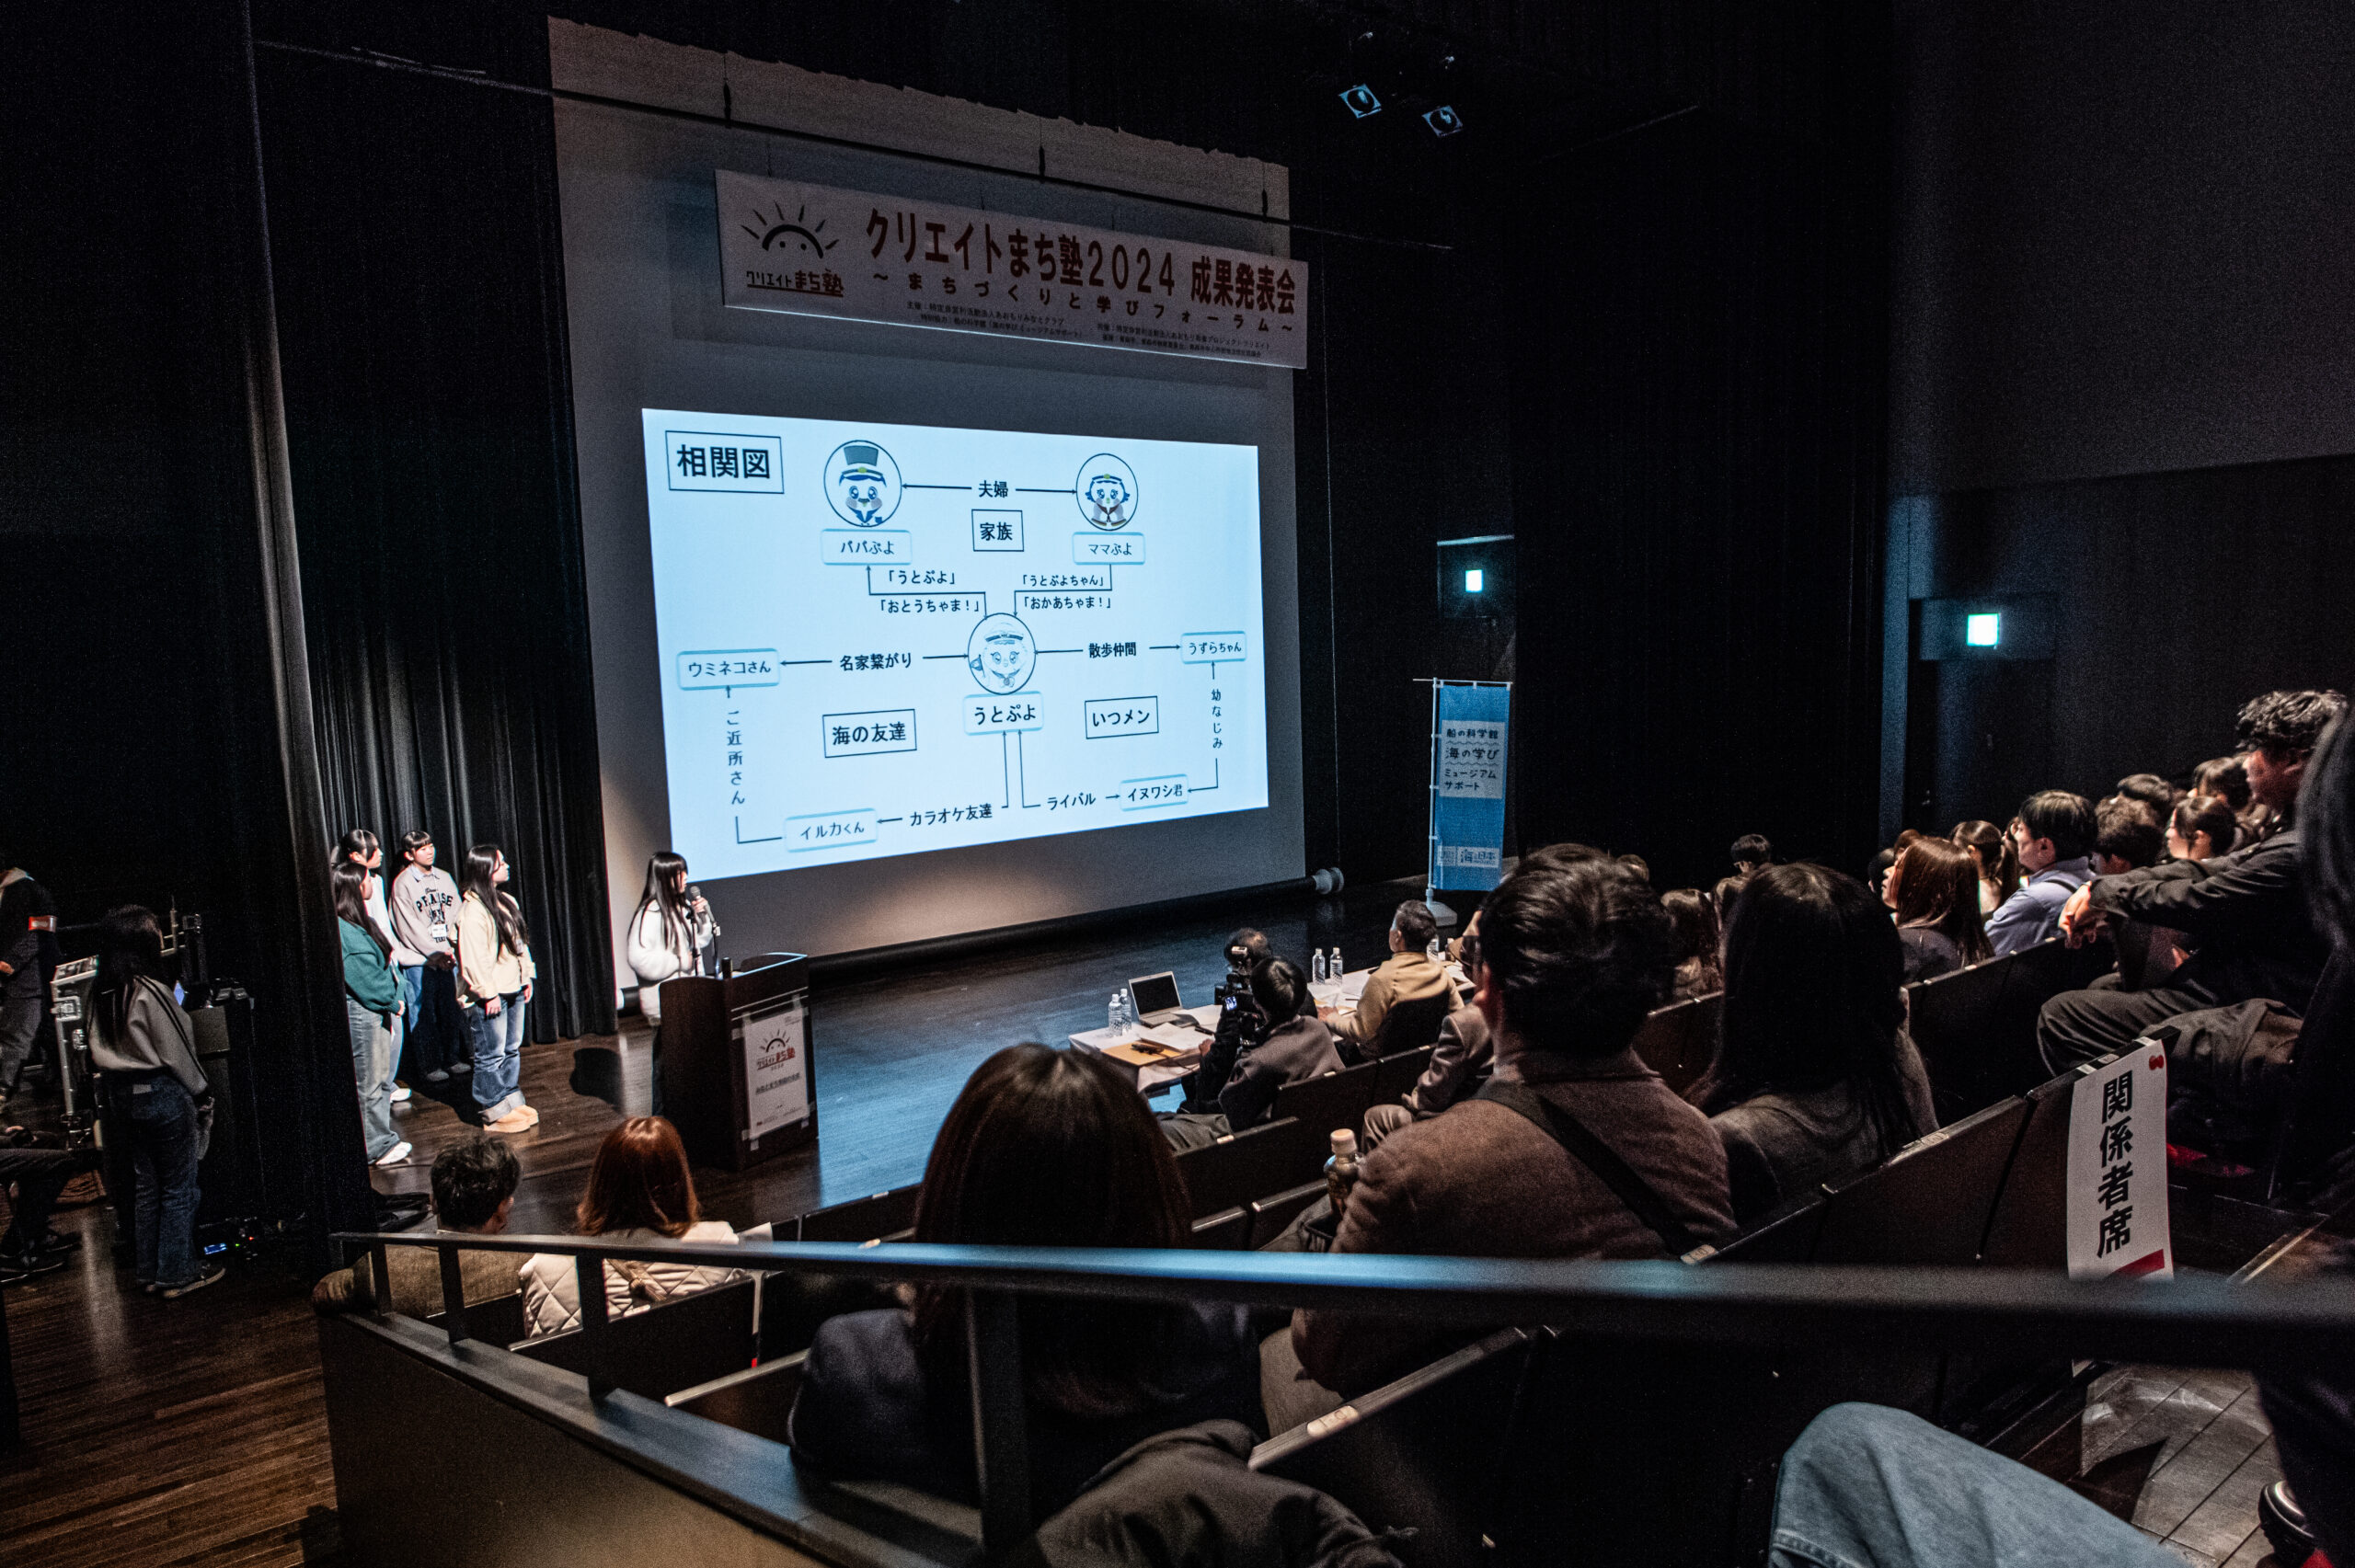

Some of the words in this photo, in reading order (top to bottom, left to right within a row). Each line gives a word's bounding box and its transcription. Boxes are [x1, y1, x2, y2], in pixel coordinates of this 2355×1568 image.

[867, 208, 1175, 296] クリエイトまち塾2024
[1190, 256, 1295, 315] 成果発表会
[746, 269, 844, 293] クリエイトまち塾
[676, 443, 771, 480] 相関図
[978, 479, 1009, 498] 夫婦
[979, 521, 1013, 542] 家族
[840, 540, 894, 555] パパぷよ
[1088, 542, 1132, 556] ママぷよ
[889, 569, 956, 585] 「うとぷよ」
[1088, 641, 1137, 659] 散歩仲間
[1189, 641, 1242, 656] うずらちゃん
[688, 660, 772, 678] ウミネコさん
[839, 652, 912, 671] 名家繋がり
[974, 704, 1037, 726] うとぷよ
[1092, 709, 1150, 727] いつメン
[1211, 688, 1223, 749] 幼なじみ
[832, 721, 906, 746] 海の友達
[1446, 728, 1499, 739] 船の科学館
[1445, 747, 1499, 761] 海の学び
[1444, 769, 1497, 780] ミュージアム
[1127, 784, 1183, 802] イヌワシ君
[1444, 781, 1480, 791] サポート
[1047, 792, 1097, 811] ライバル
[910, 803, 993, 827] カラオケ友達
[800, 821, 865, 841] イルカくん
[2097, 1070, 2133, 1258] 関係者席
